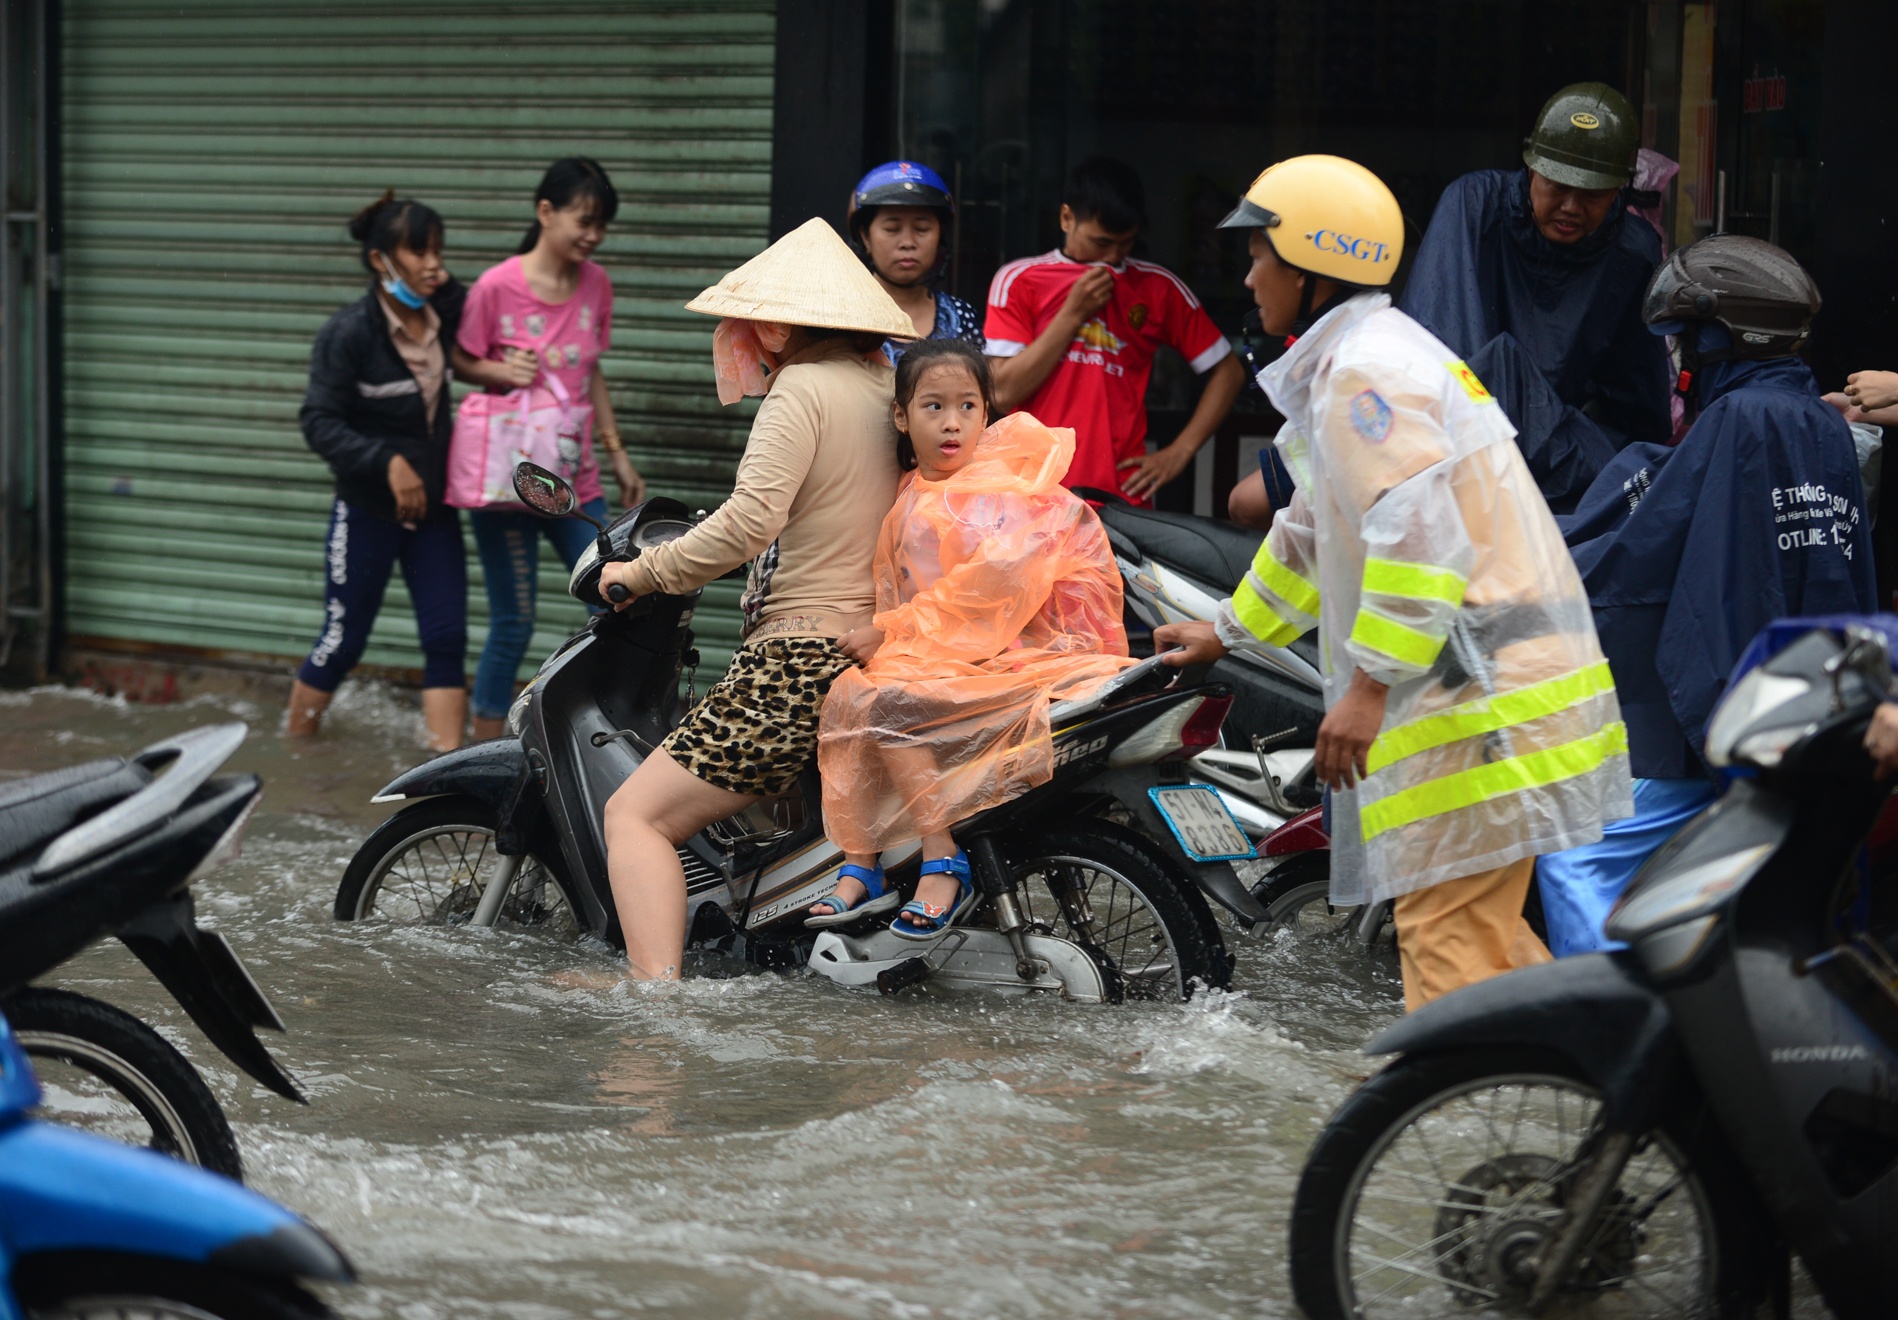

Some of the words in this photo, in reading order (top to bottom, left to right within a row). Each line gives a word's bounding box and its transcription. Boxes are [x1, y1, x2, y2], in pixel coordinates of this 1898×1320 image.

[1313, 229, 1388, 263] CSGT
[1771, 487, 1784, 511] Ệ
[1777, 528, 1828, 551] OTLINE:
[1185, 823, 1243, 855] 8386
[752, 904, 779, 924] 125
[790, 892, 816, 907] STROKE
[816, 880, 839, 895] TECHN
[1770, 1045, 1866, 1063] HONDA
